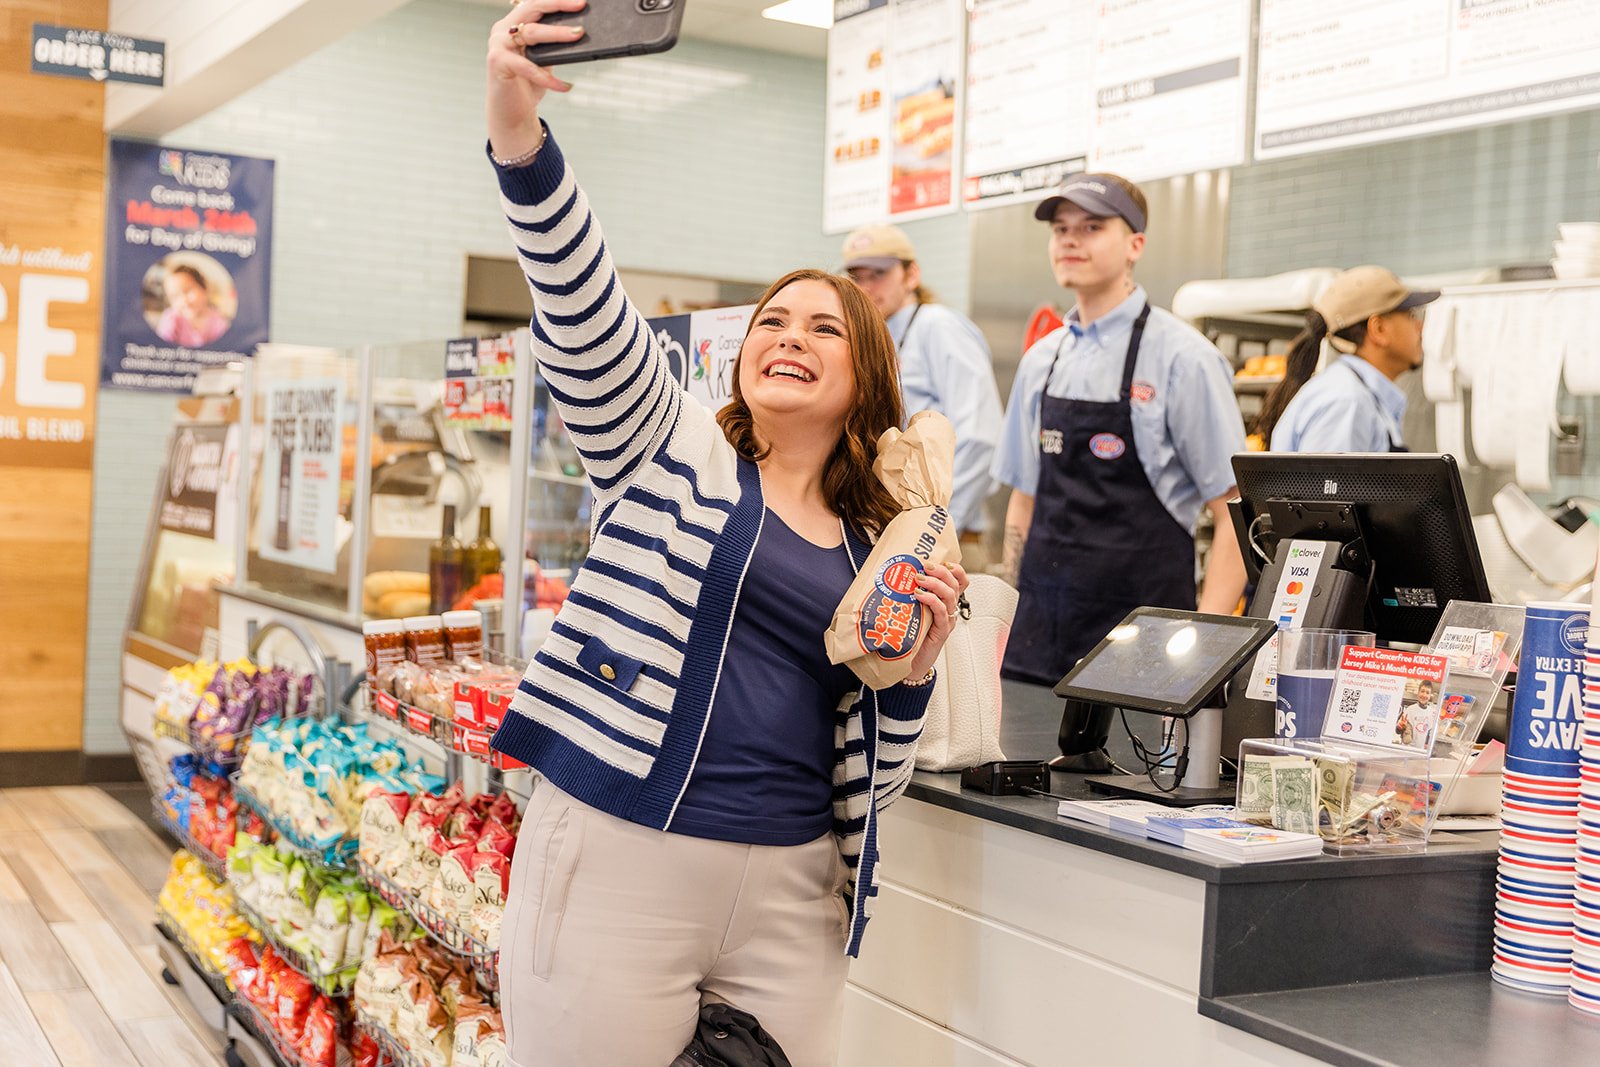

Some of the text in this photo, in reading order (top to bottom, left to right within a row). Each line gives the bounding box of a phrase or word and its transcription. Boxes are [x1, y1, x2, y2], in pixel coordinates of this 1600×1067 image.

[35, 38, 163, 78] ORDER HERE
[0, 272, 89, 410] E
[27, 417, 84, 442] BLEND
[914, 532, 937, 560] SUB
[1299, 548, 1321, 558] clover
[1290, 566, 1309, 577] VISA
[866, 595, 894, 648] Jerse
[908, 617, 920, 641] SUBS
[1444, 633, 1474, 643] DOWNLOAD
[1348, 647, 1442, 666] Support CancerFree KIDS for
[1535, 656, 1571, 672] EXTRA
[1344, 658, 1442, 680] Jersey Mike's Month of Giving!
